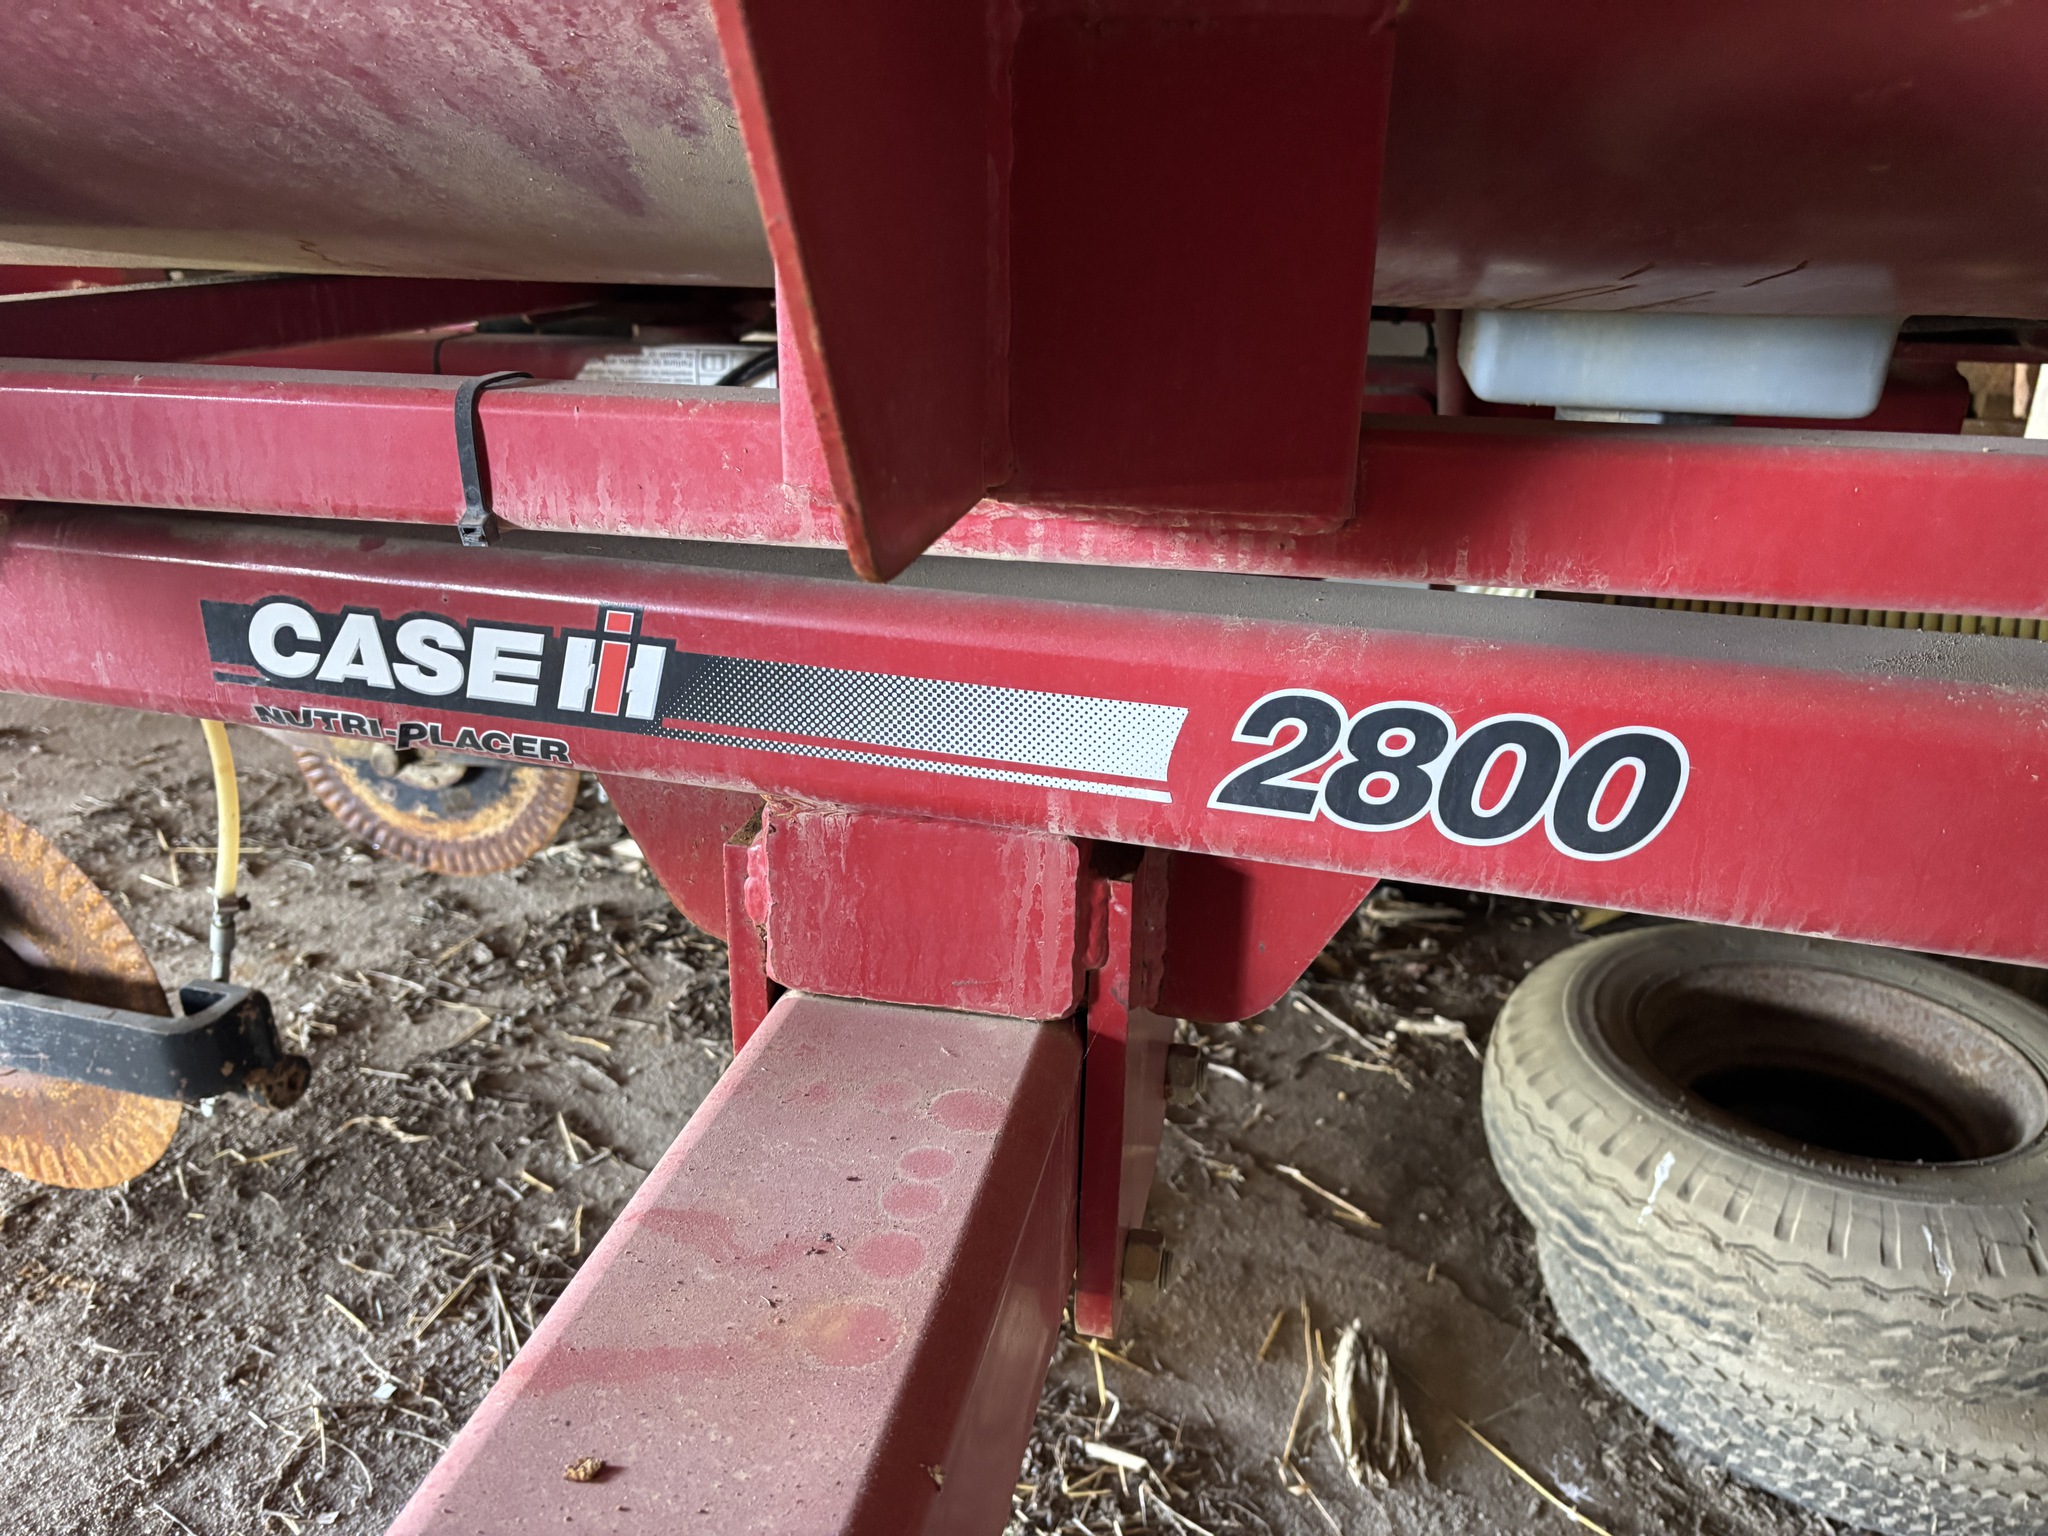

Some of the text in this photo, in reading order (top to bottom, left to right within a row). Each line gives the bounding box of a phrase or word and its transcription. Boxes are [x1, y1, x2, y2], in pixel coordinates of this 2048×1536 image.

[248, 602, 545, 706] CASE
[253, 704, 573, 764] NUTRI-PLACER
[1207, 688, 1690, 861] 2800
